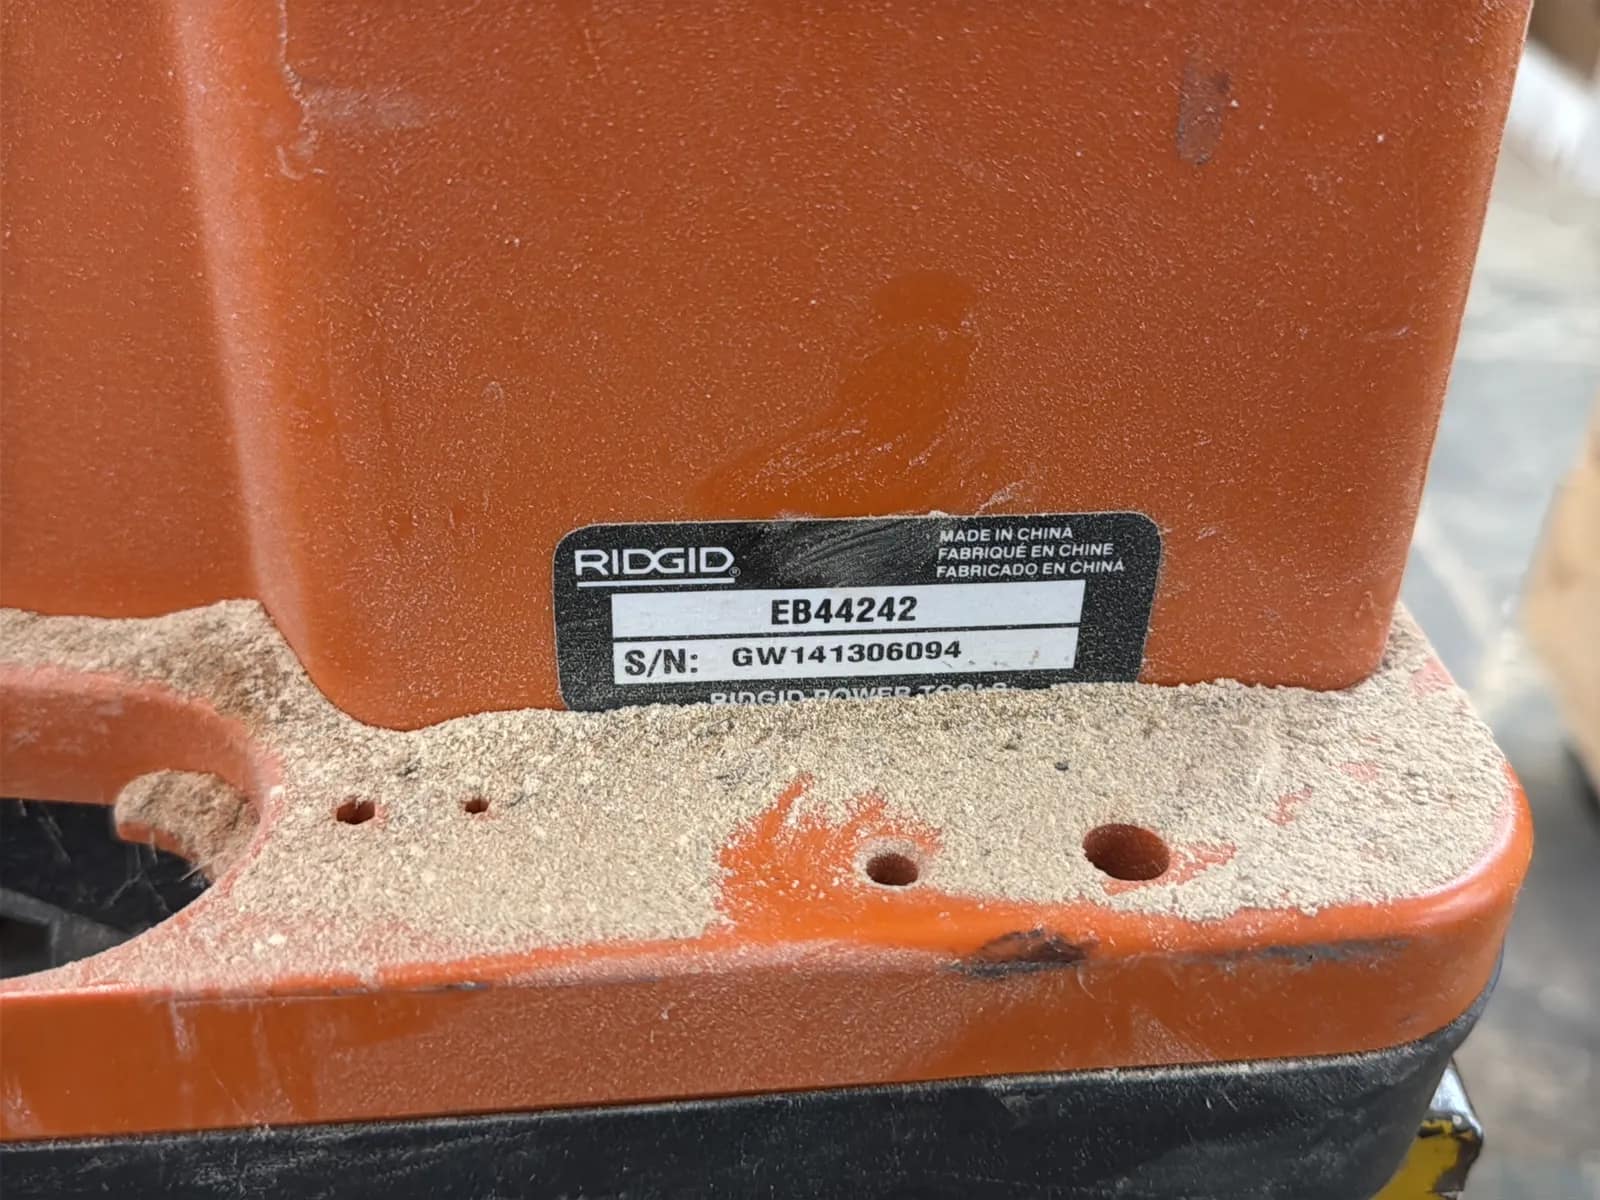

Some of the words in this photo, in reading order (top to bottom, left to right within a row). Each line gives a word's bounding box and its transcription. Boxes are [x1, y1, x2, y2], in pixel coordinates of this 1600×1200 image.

[939, 529, 991, 542] MADE
[995, 528, 1013, 540] IN
[1019, 527, 1073, 540] CHINA
[574, 547, 735, 576] RIDGID
[938, 544, 1027, 561] FABRIQUÉ
[1031, 546, 1054, 558] EN
[1059, 543, 1114, 557] CHINE
[936, 563, 1037, 578] FABRICADO
[1043, 562, 1065, 575] EN
[1069, 560, 1125, 574] CHINA
[771, 595, 918, 625] EB44242
[624, 648, 698, 677] S/N:
[732, 641, 961, 666] GW141306094
